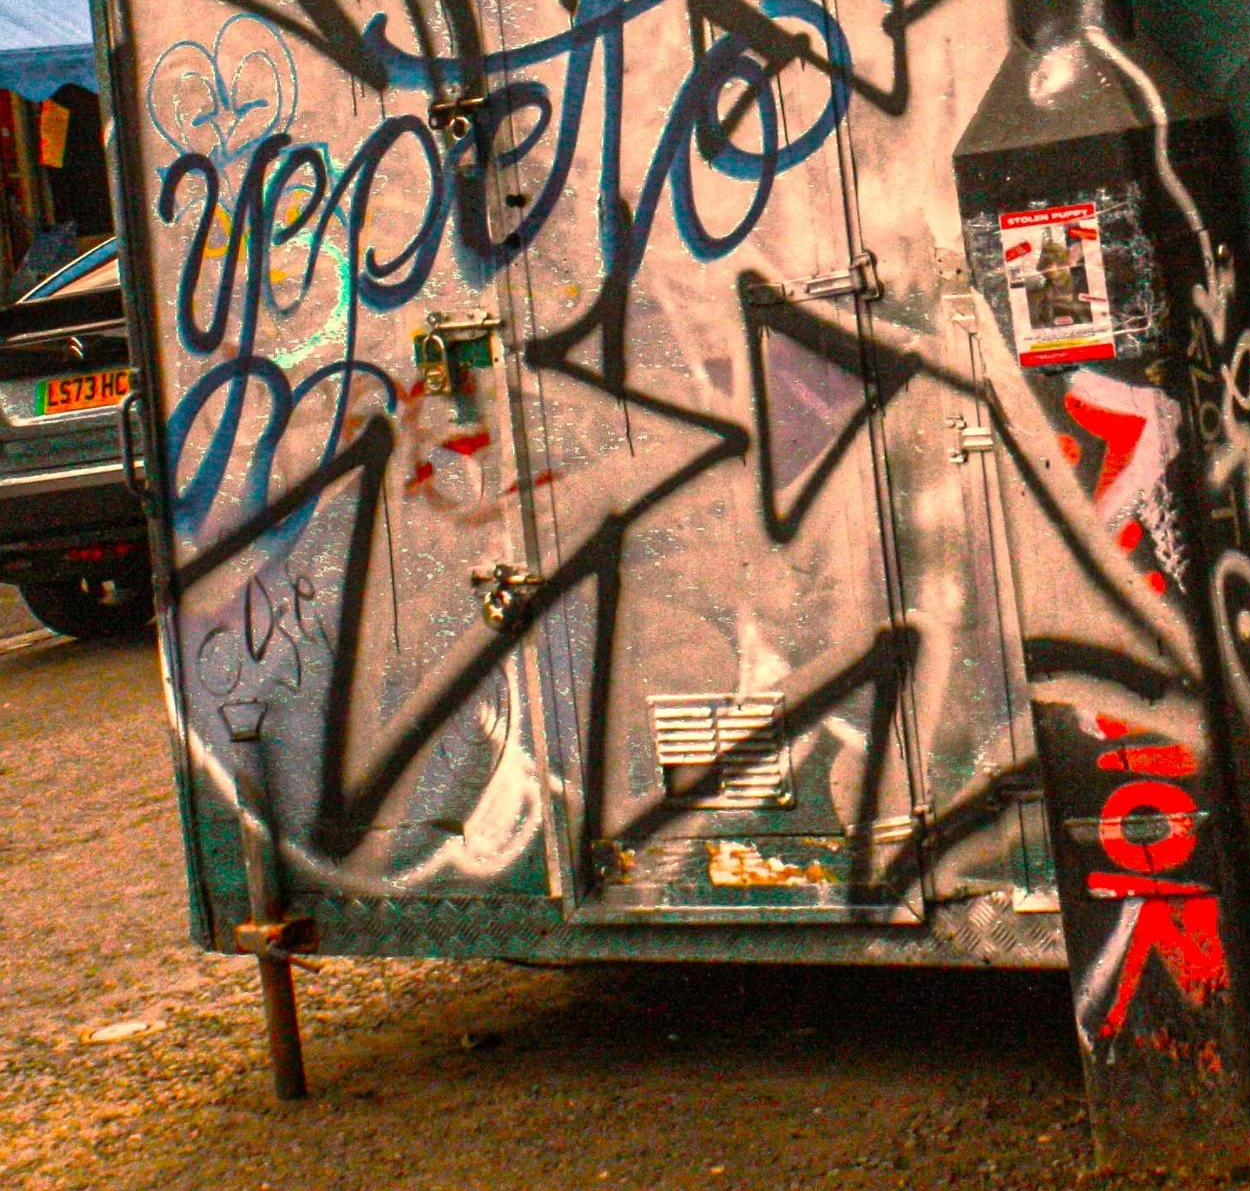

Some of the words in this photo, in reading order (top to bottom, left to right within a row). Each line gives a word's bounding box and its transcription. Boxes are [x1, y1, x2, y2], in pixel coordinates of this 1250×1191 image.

[1007, 213, 1049, 225] STOLEN
[1051, 209, 1088, 220] PUPPY
[48, 375, 98, 407] LS73
